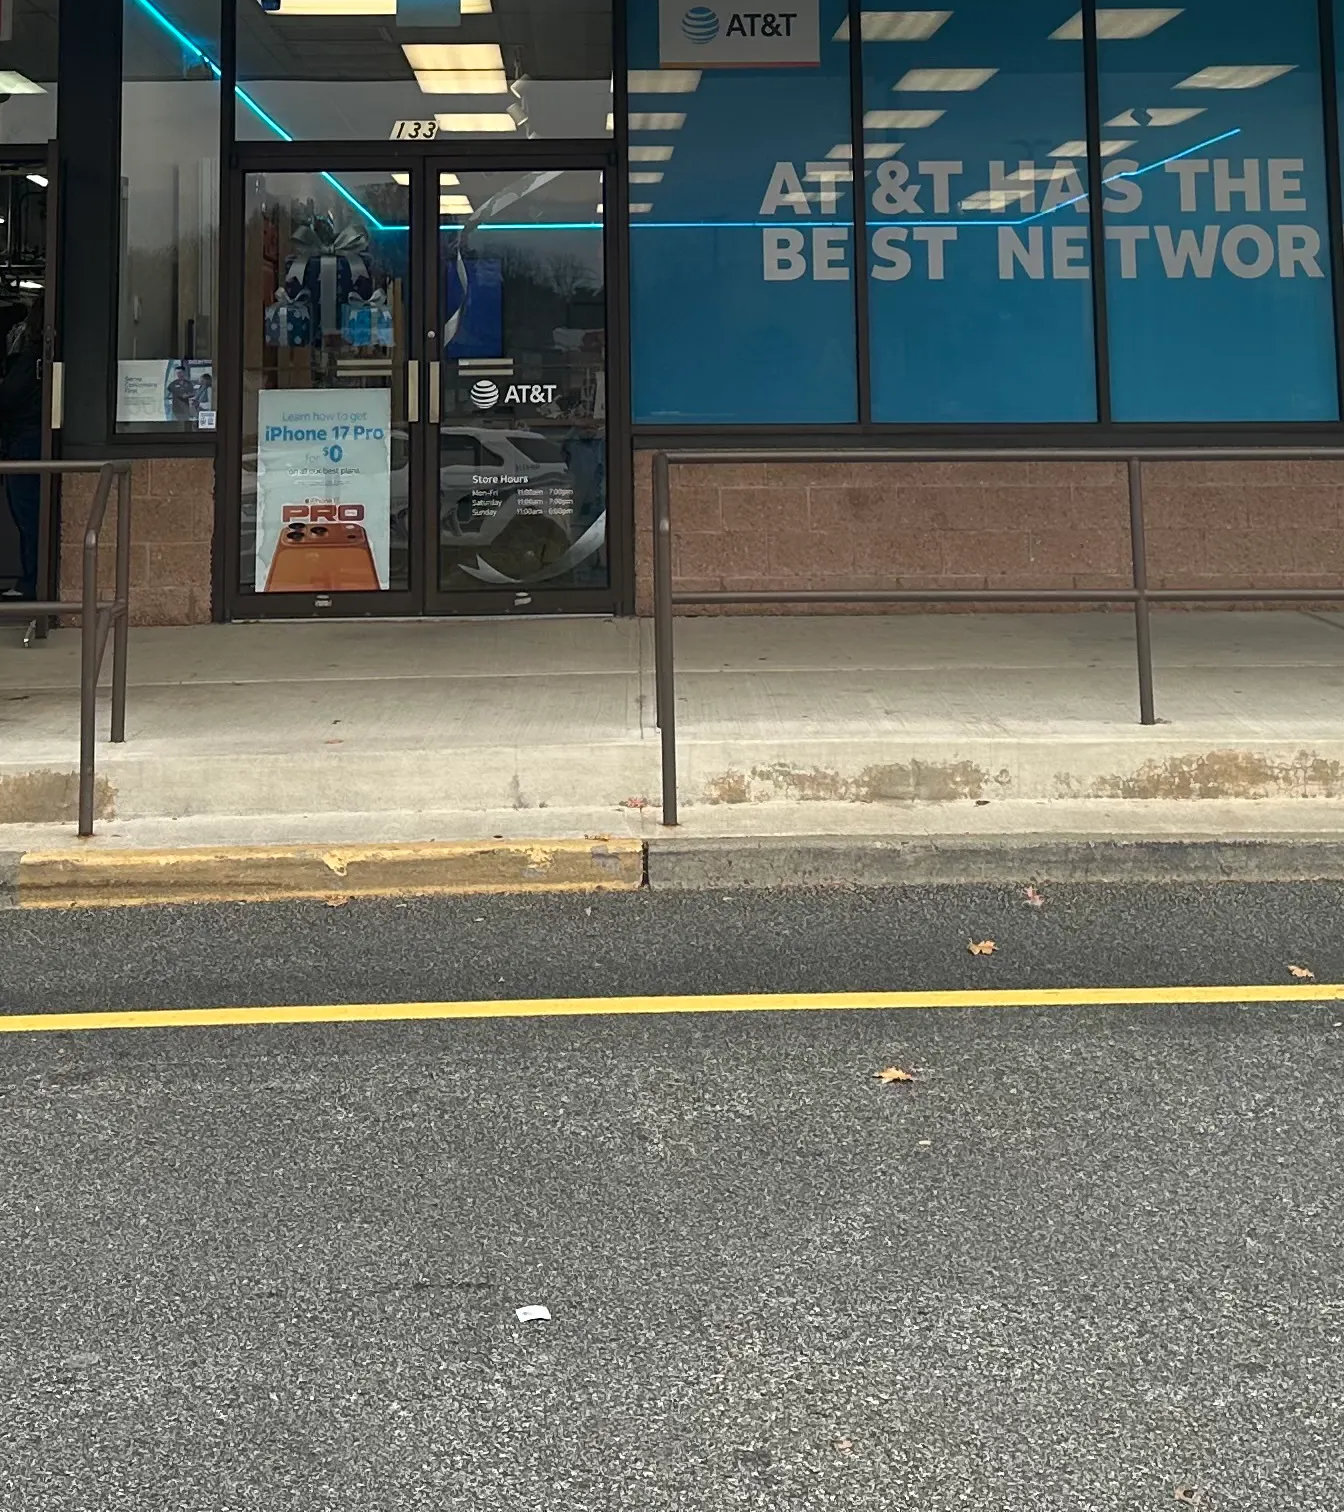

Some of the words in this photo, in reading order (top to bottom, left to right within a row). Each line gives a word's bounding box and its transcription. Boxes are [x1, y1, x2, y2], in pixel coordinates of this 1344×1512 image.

[725, 12, 797, 39] AT&T
[396, 121, 436, 138] 133
[989, 159, 1143, 215] HAS
[1165, 157, 1307, 212] THE
[762, 226, 957, 282] BEST
[504, 384, 557, 404] AT&T
[282, 411, 310, 422] Learn
[312, 411, 334, 421] how
[336, 412, 348, 421] to
[349, 411, 368, 422] get
[265, 425, 327, 441] iPhone
[331, 426, 350, 440] 17
[353, 426, 384, 440] Pro
[322, 444, 343, 463] $0
[322, 467, 339, 475] best
[472, 474, 498, 483] Store
[500, 474, 529, 483] Hours
[472, 498, 503, 506] Saturday
[282, 504, 364, 522] PRO
[472, 508, 497, 516] Sunday
